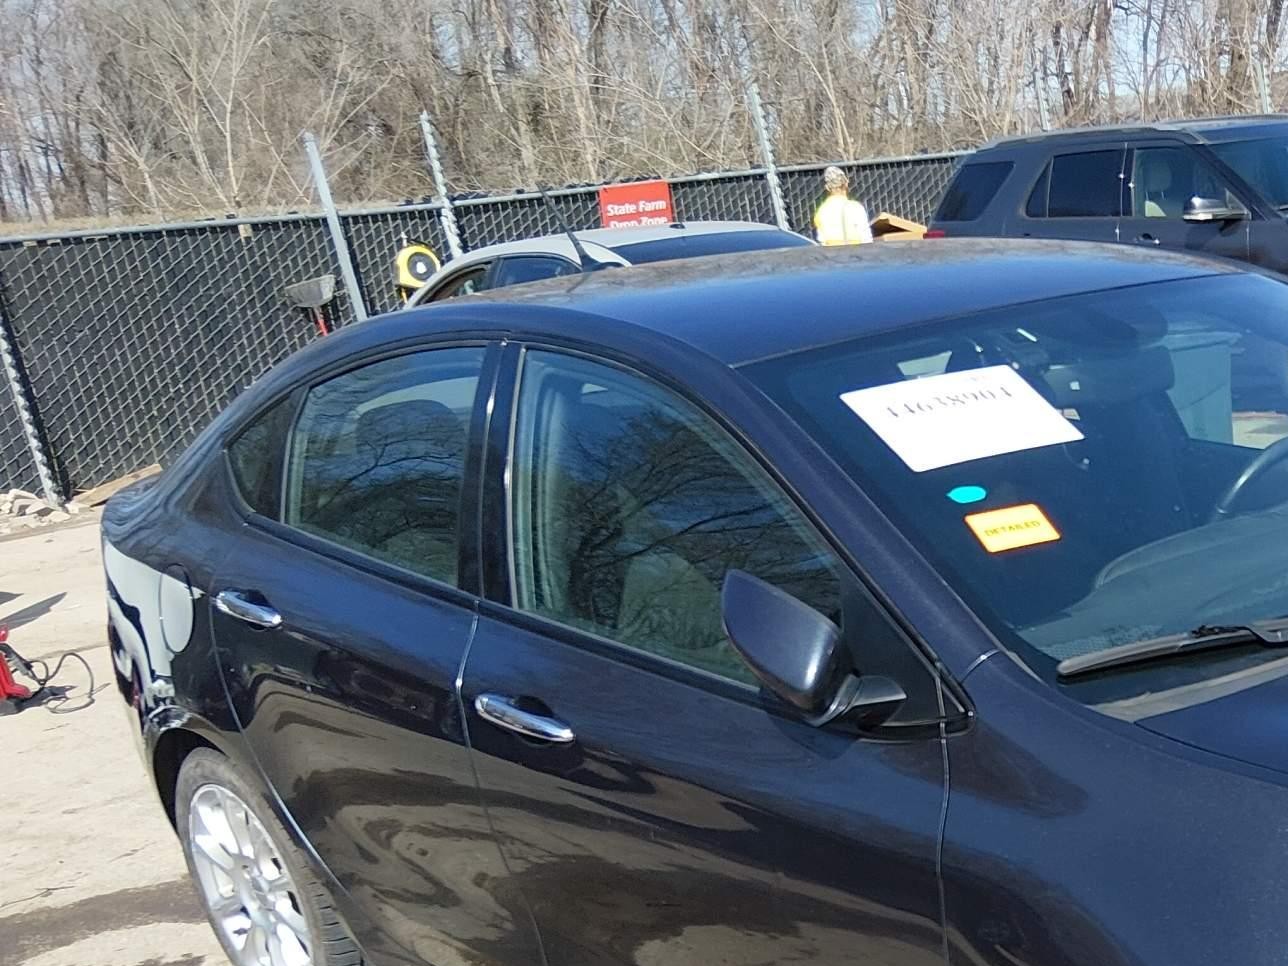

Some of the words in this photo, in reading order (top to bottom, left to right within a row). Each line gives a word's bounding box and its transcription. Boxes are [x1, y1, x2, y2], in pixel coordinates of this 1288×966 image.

[607, 203, 636, 217] State
[638, 199, 666, 212] Farm
[639, 215, 667, 226] Zone
[983, 520, 1042, 537] DETAILED
